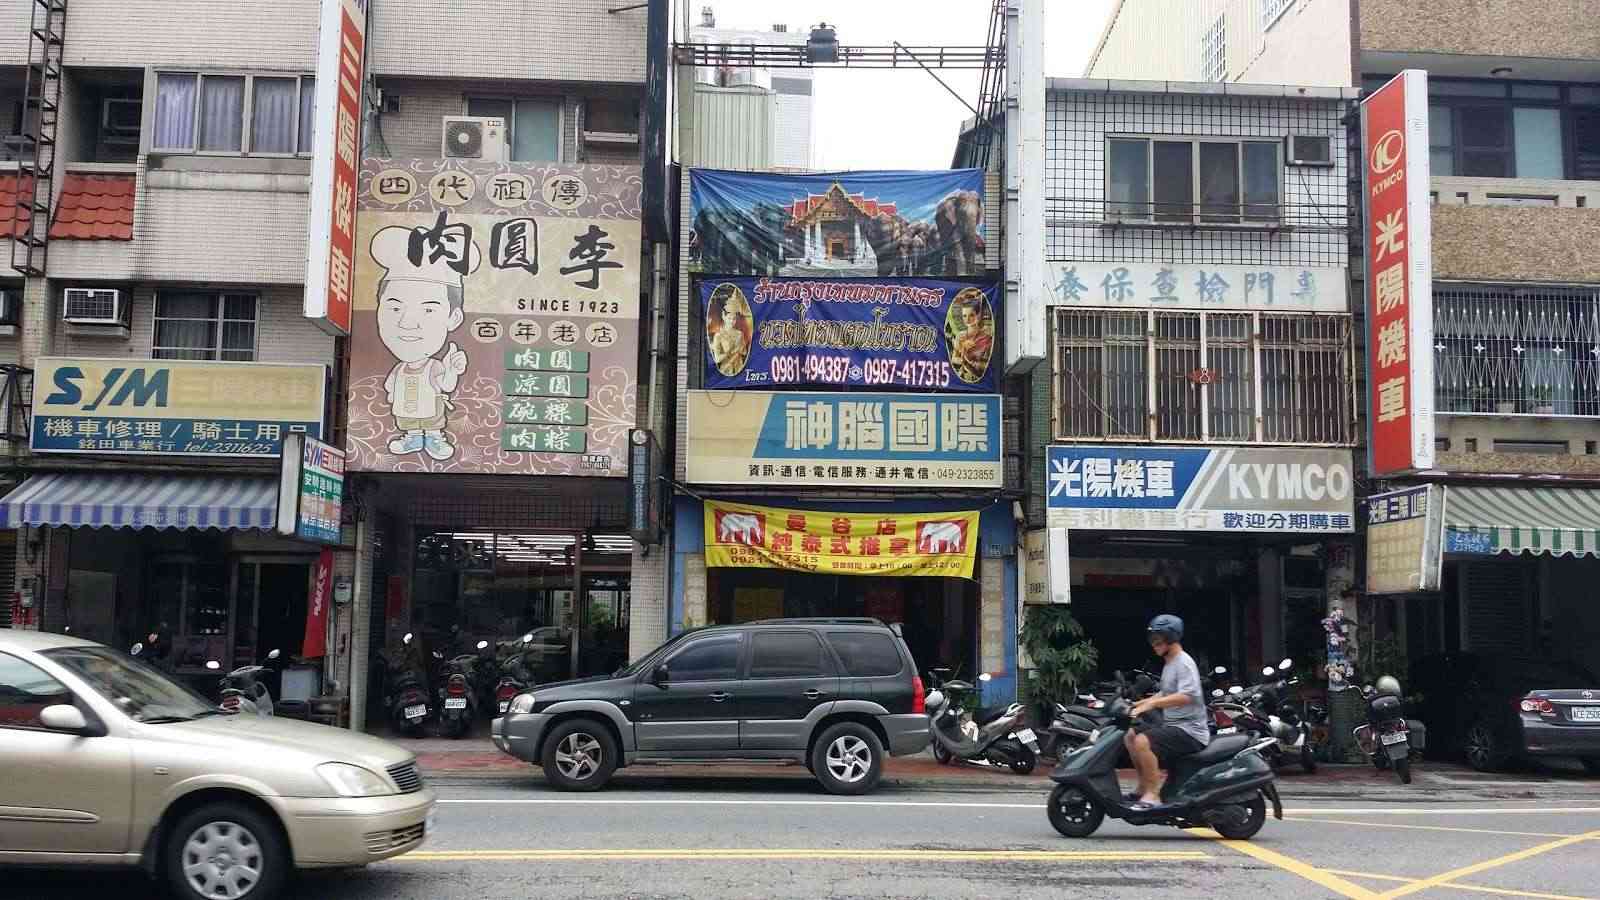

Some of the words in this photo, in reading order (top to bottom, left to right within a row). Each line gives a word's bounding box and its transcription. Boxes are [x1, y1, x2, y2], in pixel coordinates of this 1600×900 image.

[379, 175, 582, 205] 四代祖傳
[1371, 168, 1403, 198] KYMCO
[407, 209, 624, 290] 肉圓李
[517, 298, 570, 313] SINCE
[579, 300, 619, 314] 1923
[1375, 207, 1406, 424] 光陽機車
[474, 321, 613, 344] 百年老店
[513, 348, 573, 371] 肉圓
[771, 354, 850, 384] 0981-494387
[864, 357, 950, 387] 0987-417315
[44, 366, 170, 411] SYM
[513, 373, 572, 396] 涼圓
[43, 417, 162, 440] 機車修理
[784, 400, 990, 453] 神腦國際
[1049, 457, 1175, 499] 光陽機車
[1228, 463, 1350, 501] KYMCO
[1222, 511, 1352, 531] 歡迎分期購車
